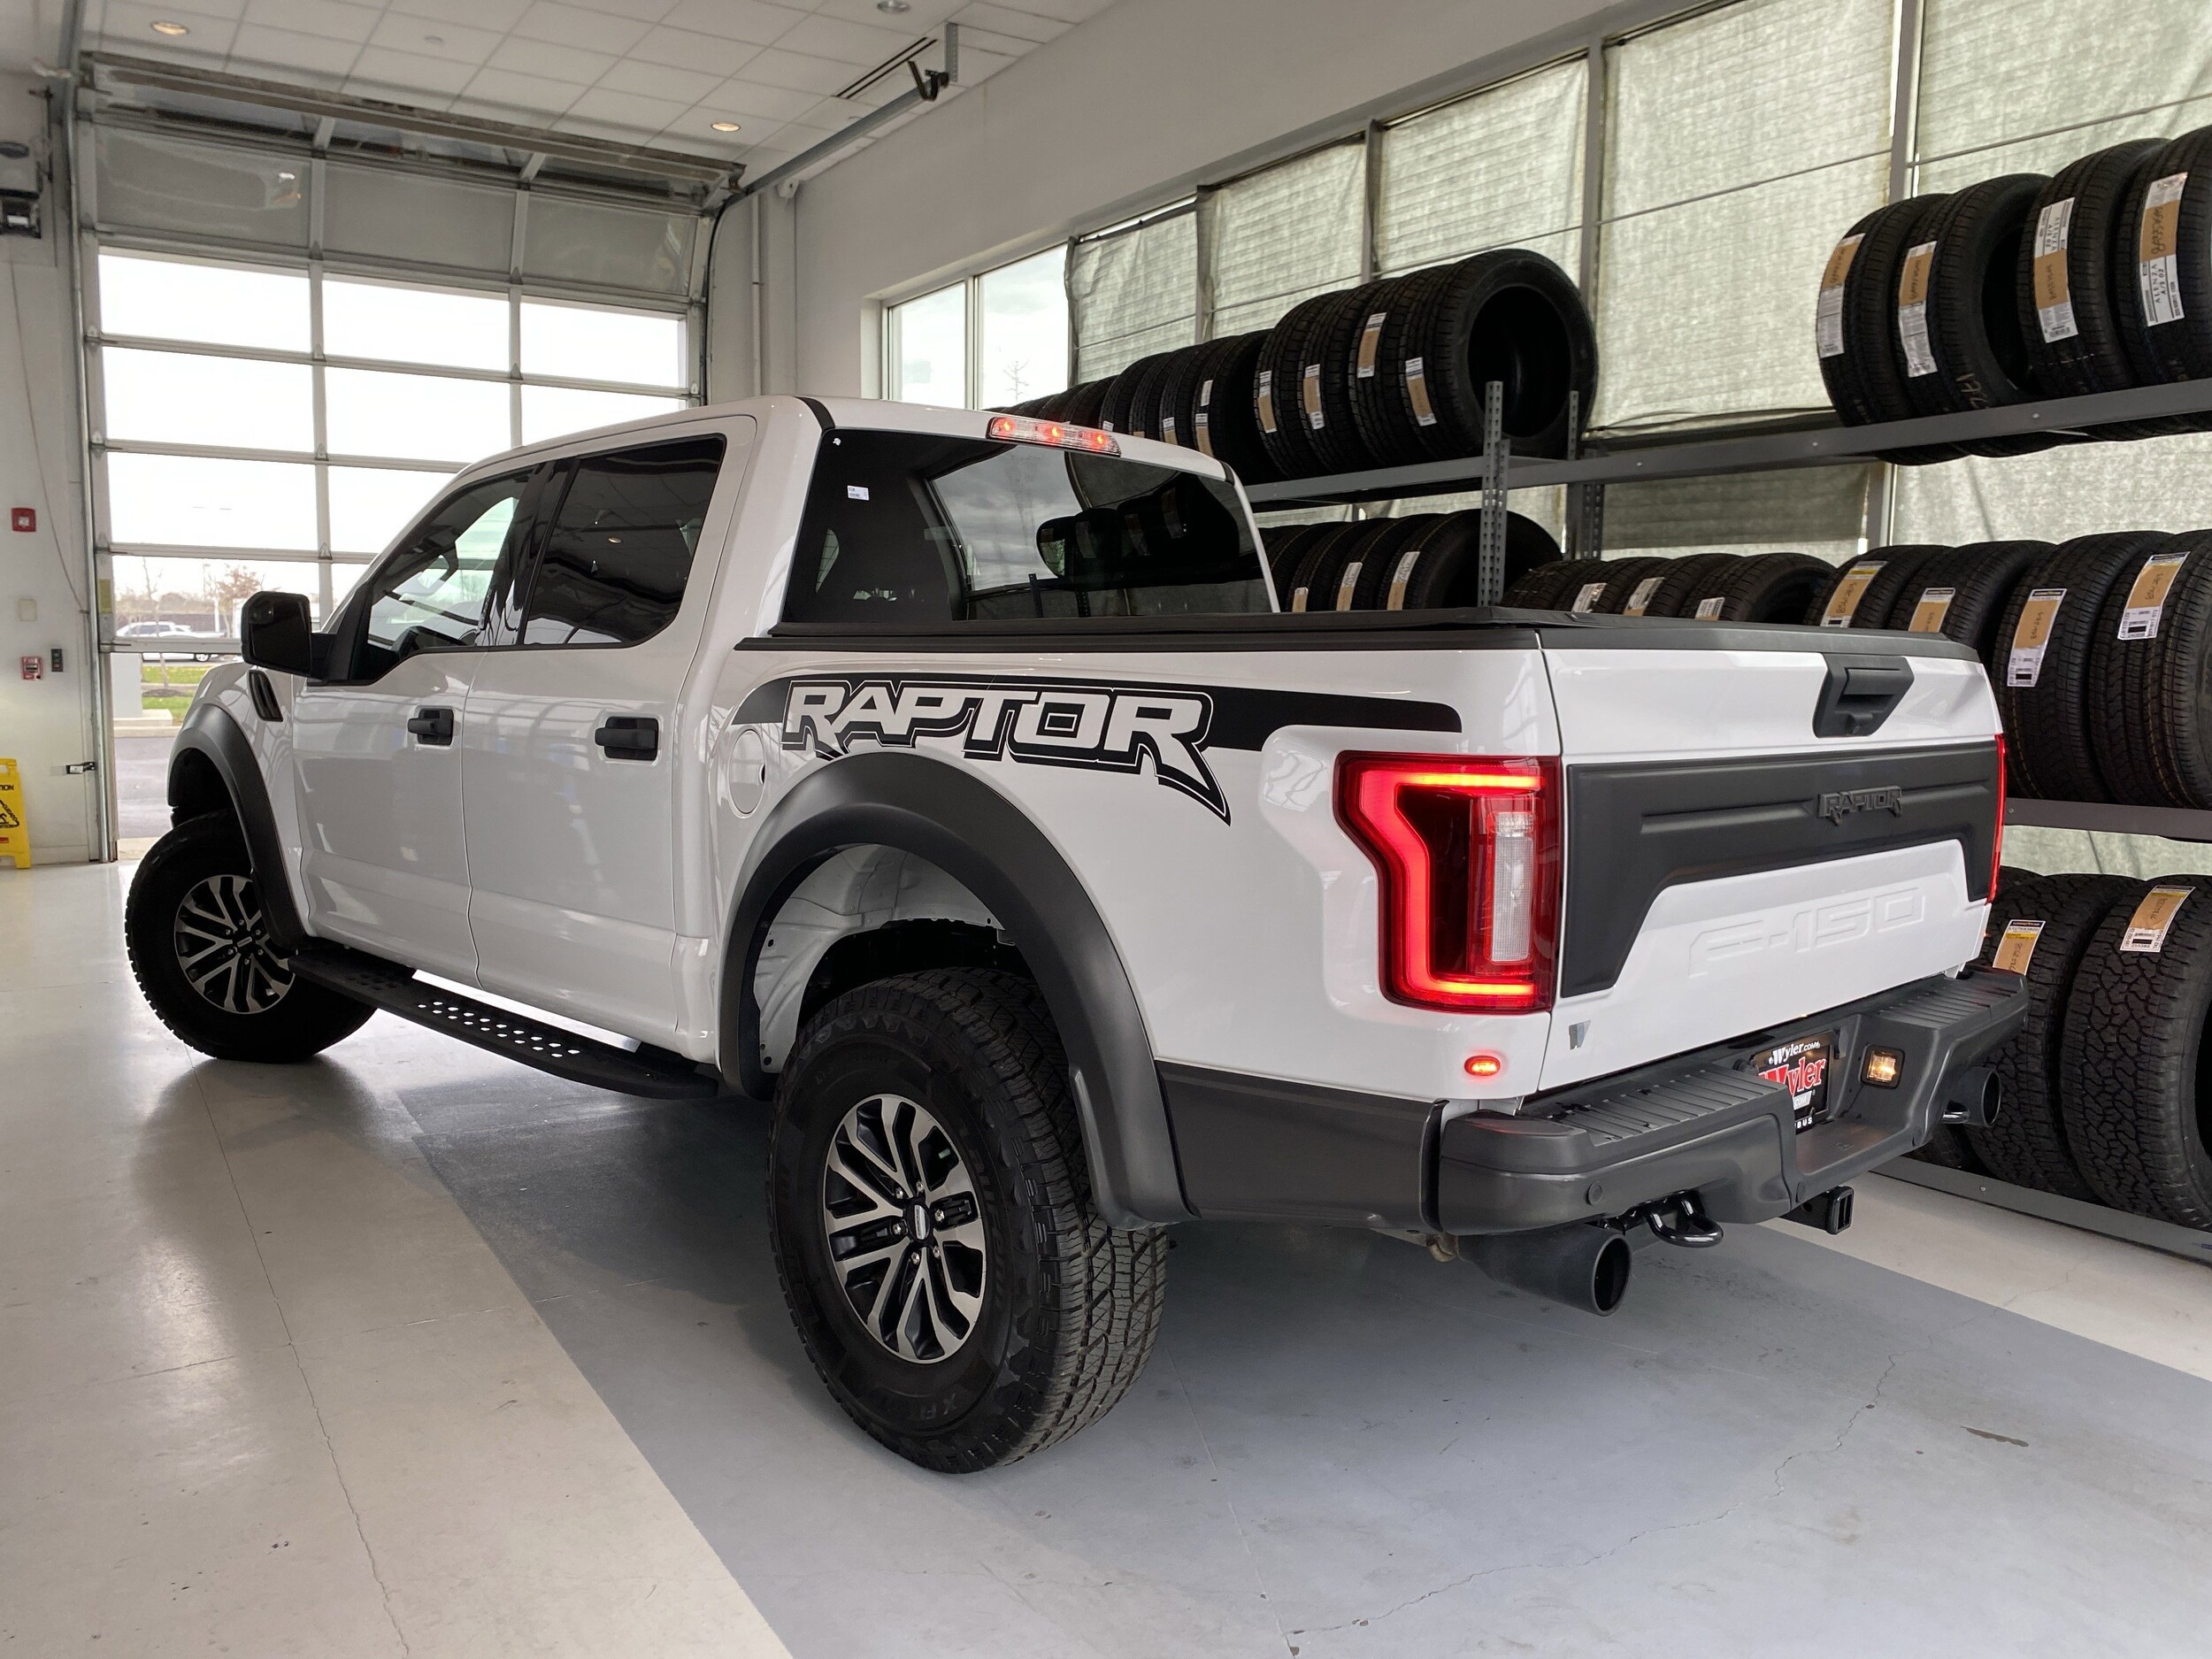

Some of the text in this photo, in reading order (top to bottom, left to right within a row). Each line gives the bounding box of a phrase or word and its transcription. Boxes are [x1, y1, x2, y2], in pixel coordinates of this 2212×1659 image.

[782, 678, 1231, 826] RAPTOR
[1817, 786, 1902, 827] RAPTOR
[1687, 887, 1926, 979] F-150
